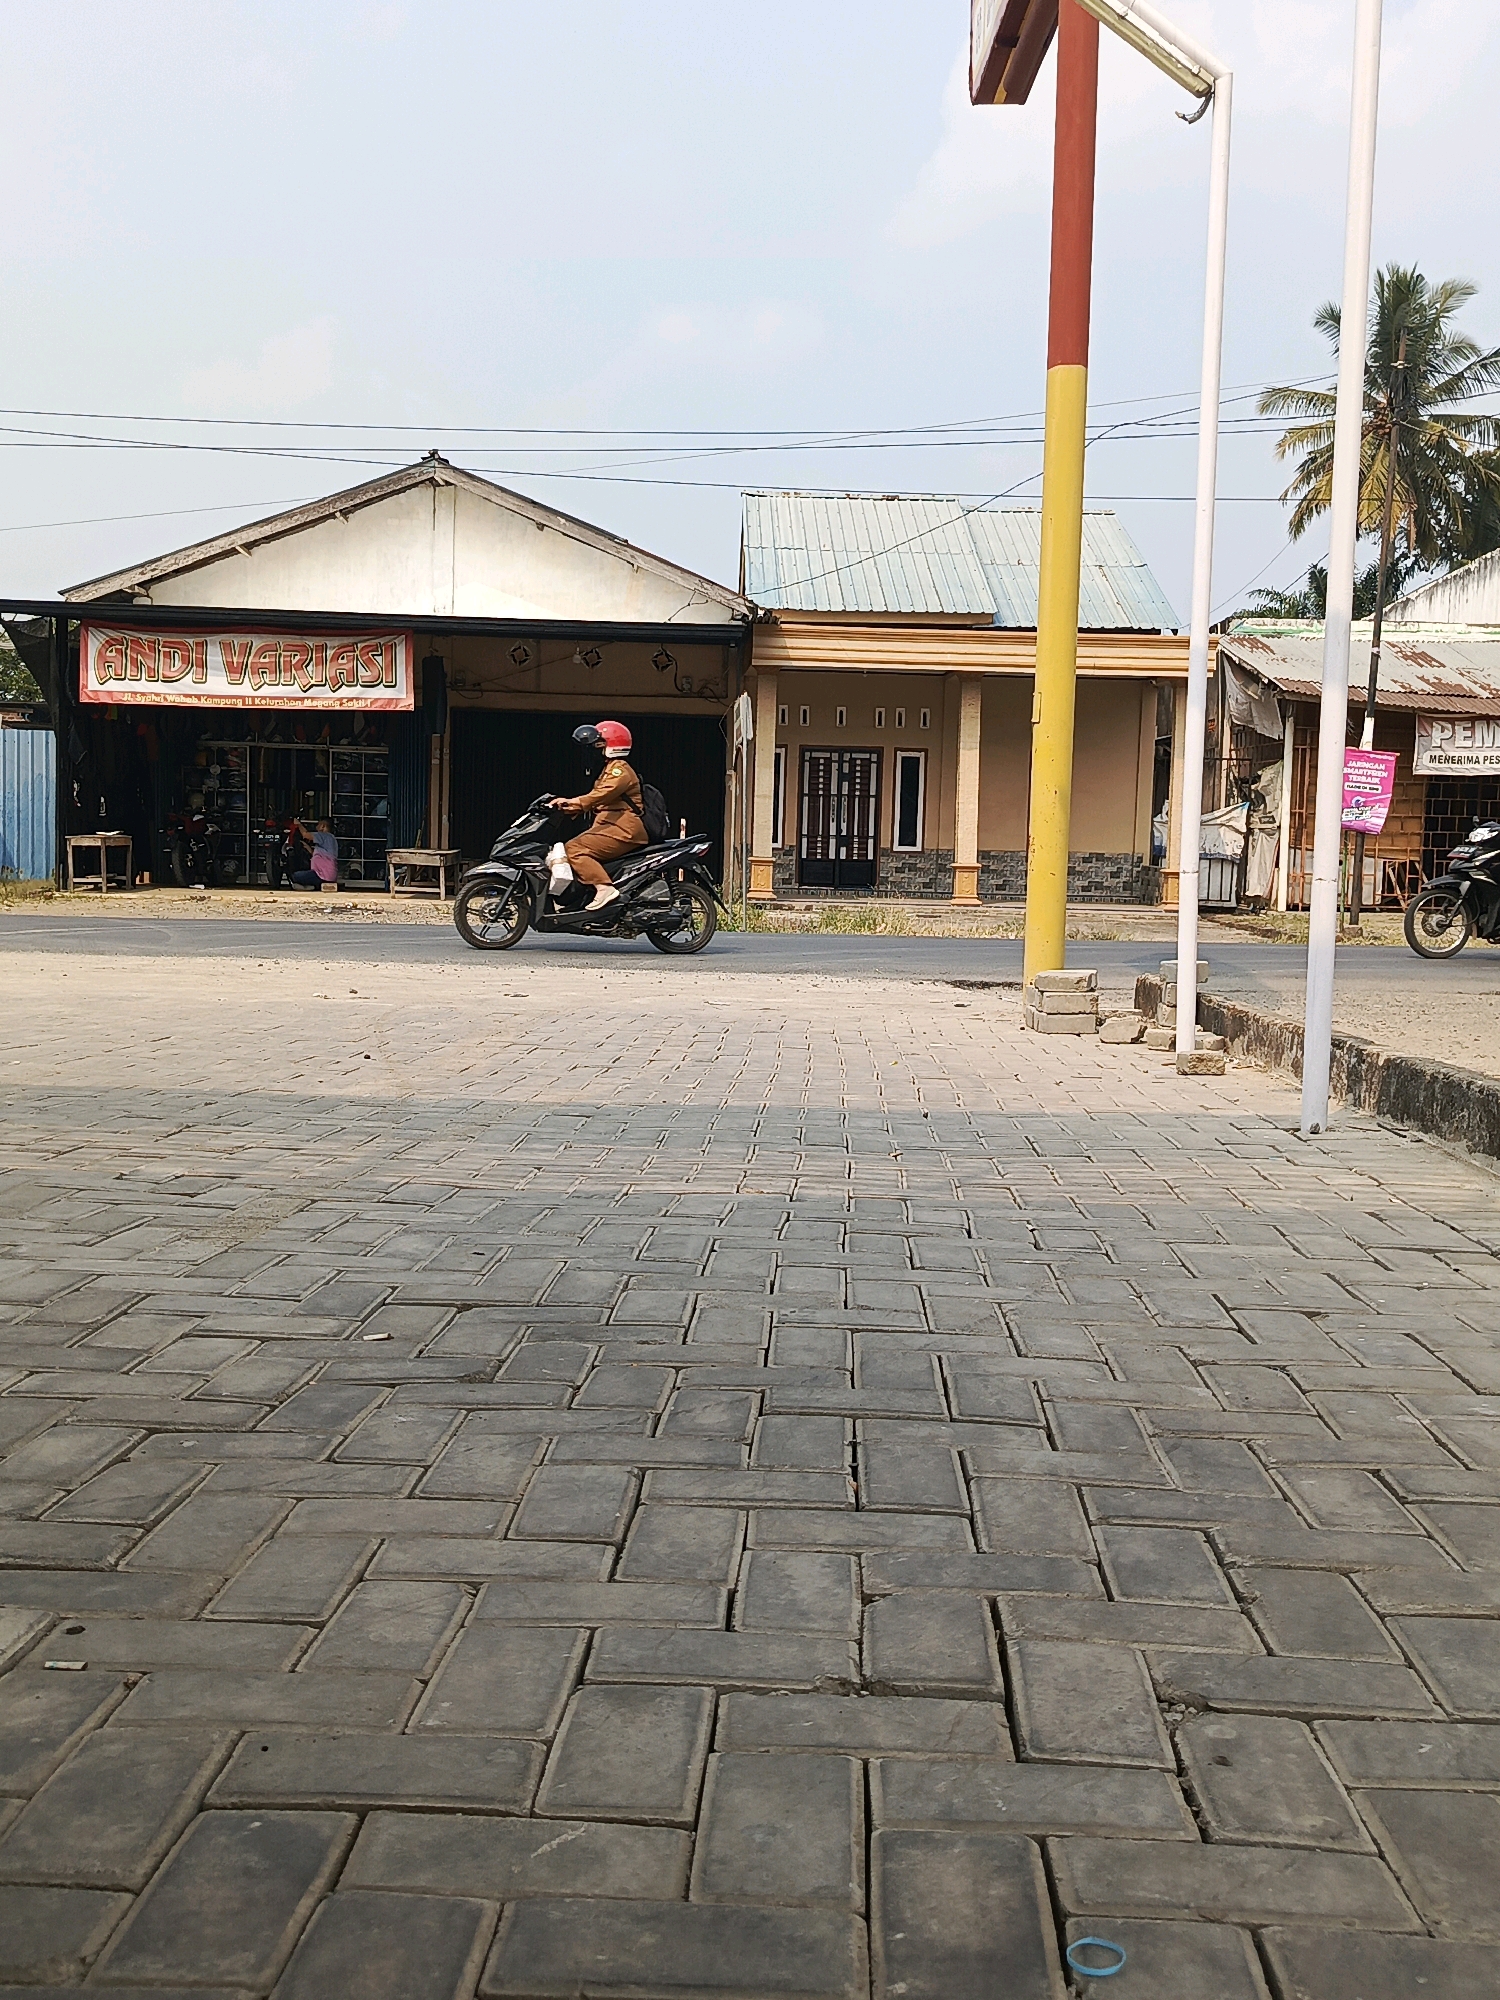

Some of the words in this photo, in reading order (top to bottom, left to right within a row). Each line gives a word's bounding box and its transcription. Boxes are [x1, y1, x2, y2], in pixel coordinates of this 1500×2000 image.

[94, 636, 207, 685] ANDI
[219, 639, 397, 693] VARIASI
[201, 696, 242, 706] Kampung
[255, 697, 301, 706] Kelurahan
[1429, 755, 1480, 765] MENERIMA
[1347, 761, 1386, 771] JARINGAN
